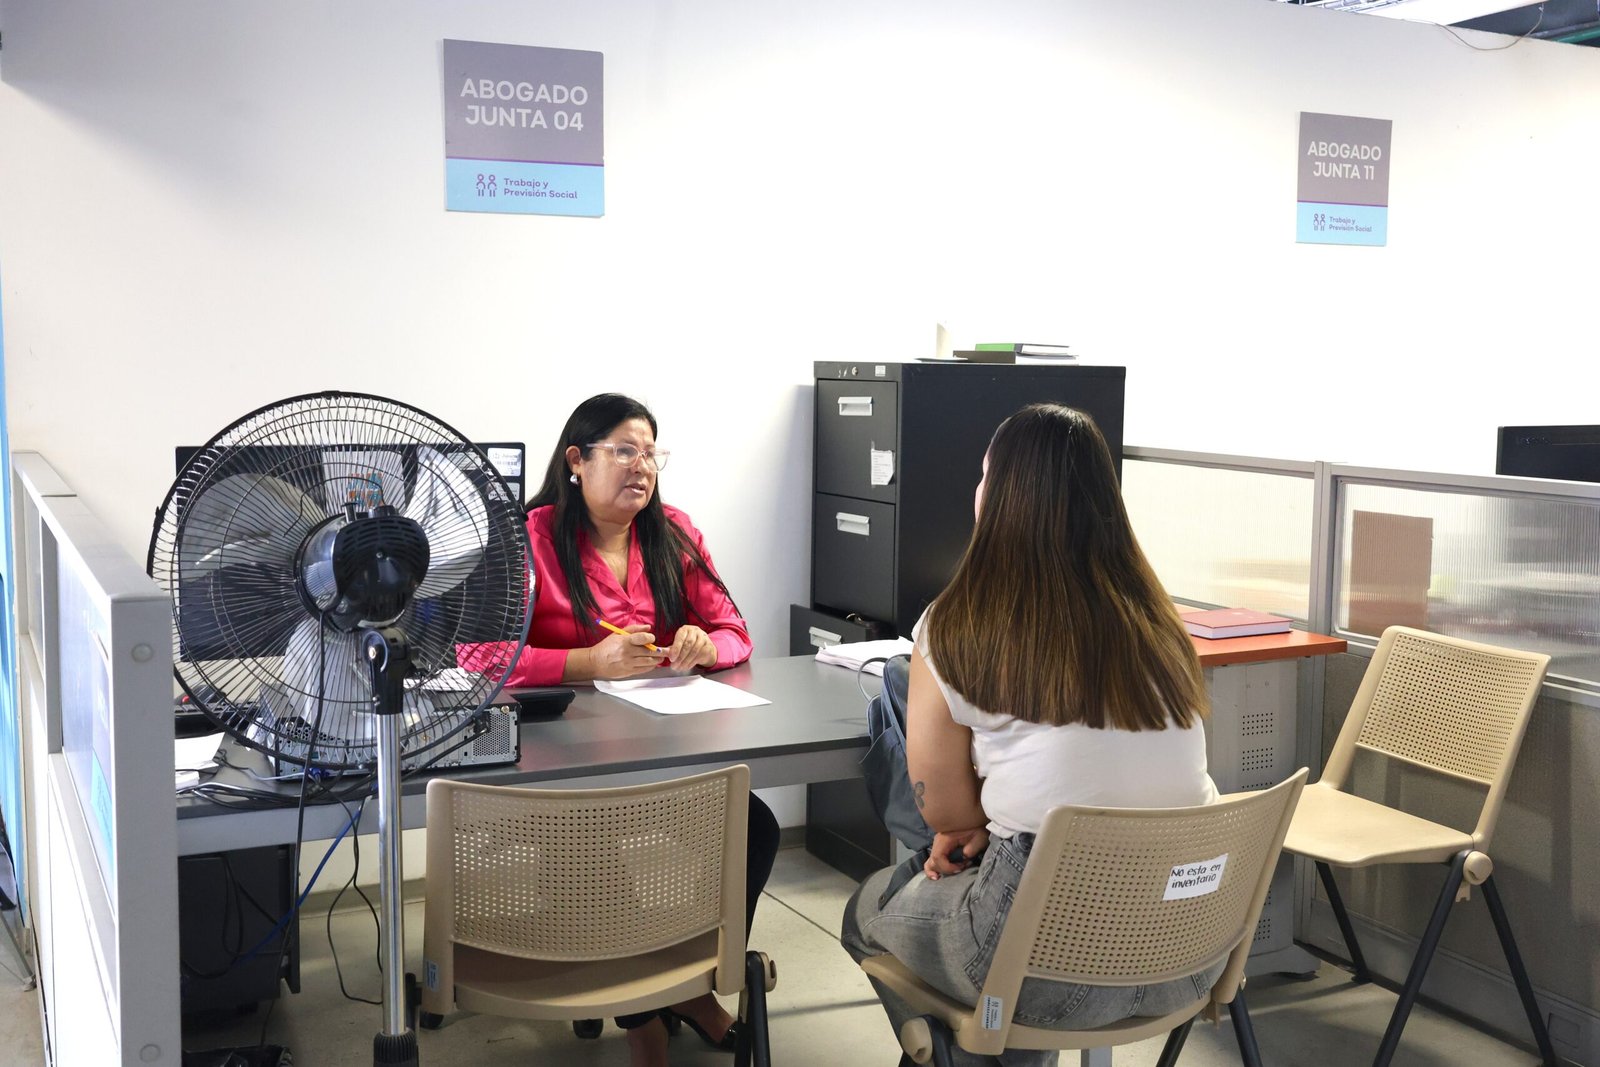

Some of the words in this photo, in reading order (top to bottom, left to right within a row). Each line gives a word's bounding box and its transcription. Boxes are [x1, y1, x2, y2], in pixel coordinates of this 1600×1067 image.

[460, 78, 588, 106] ABOGADO
[465, 105, 548, 129] JUNTA
[553, 110, 584, 132] 04
[1308, 141, 1381, 161] ABOGADO
[1313, 162, 1360, 179] JUNTA
[1364, 166, 1374, 180] 11
[503, 177, 541, 192] Trabajo
[542, 180, 549, 189] y
[503, 188, 547, 198] Previsión
[549, 190, 578, 200] Social
[1329, 217, 1351, 226] Trabajo
[1355, 225, 1373, 233] Social
[1171, 869, 1184, 877] No
[1187, 865, 1207, 876] esta
[1210, 863, 1221, 872] en
[1172, 874, 1216, 888] inventario
